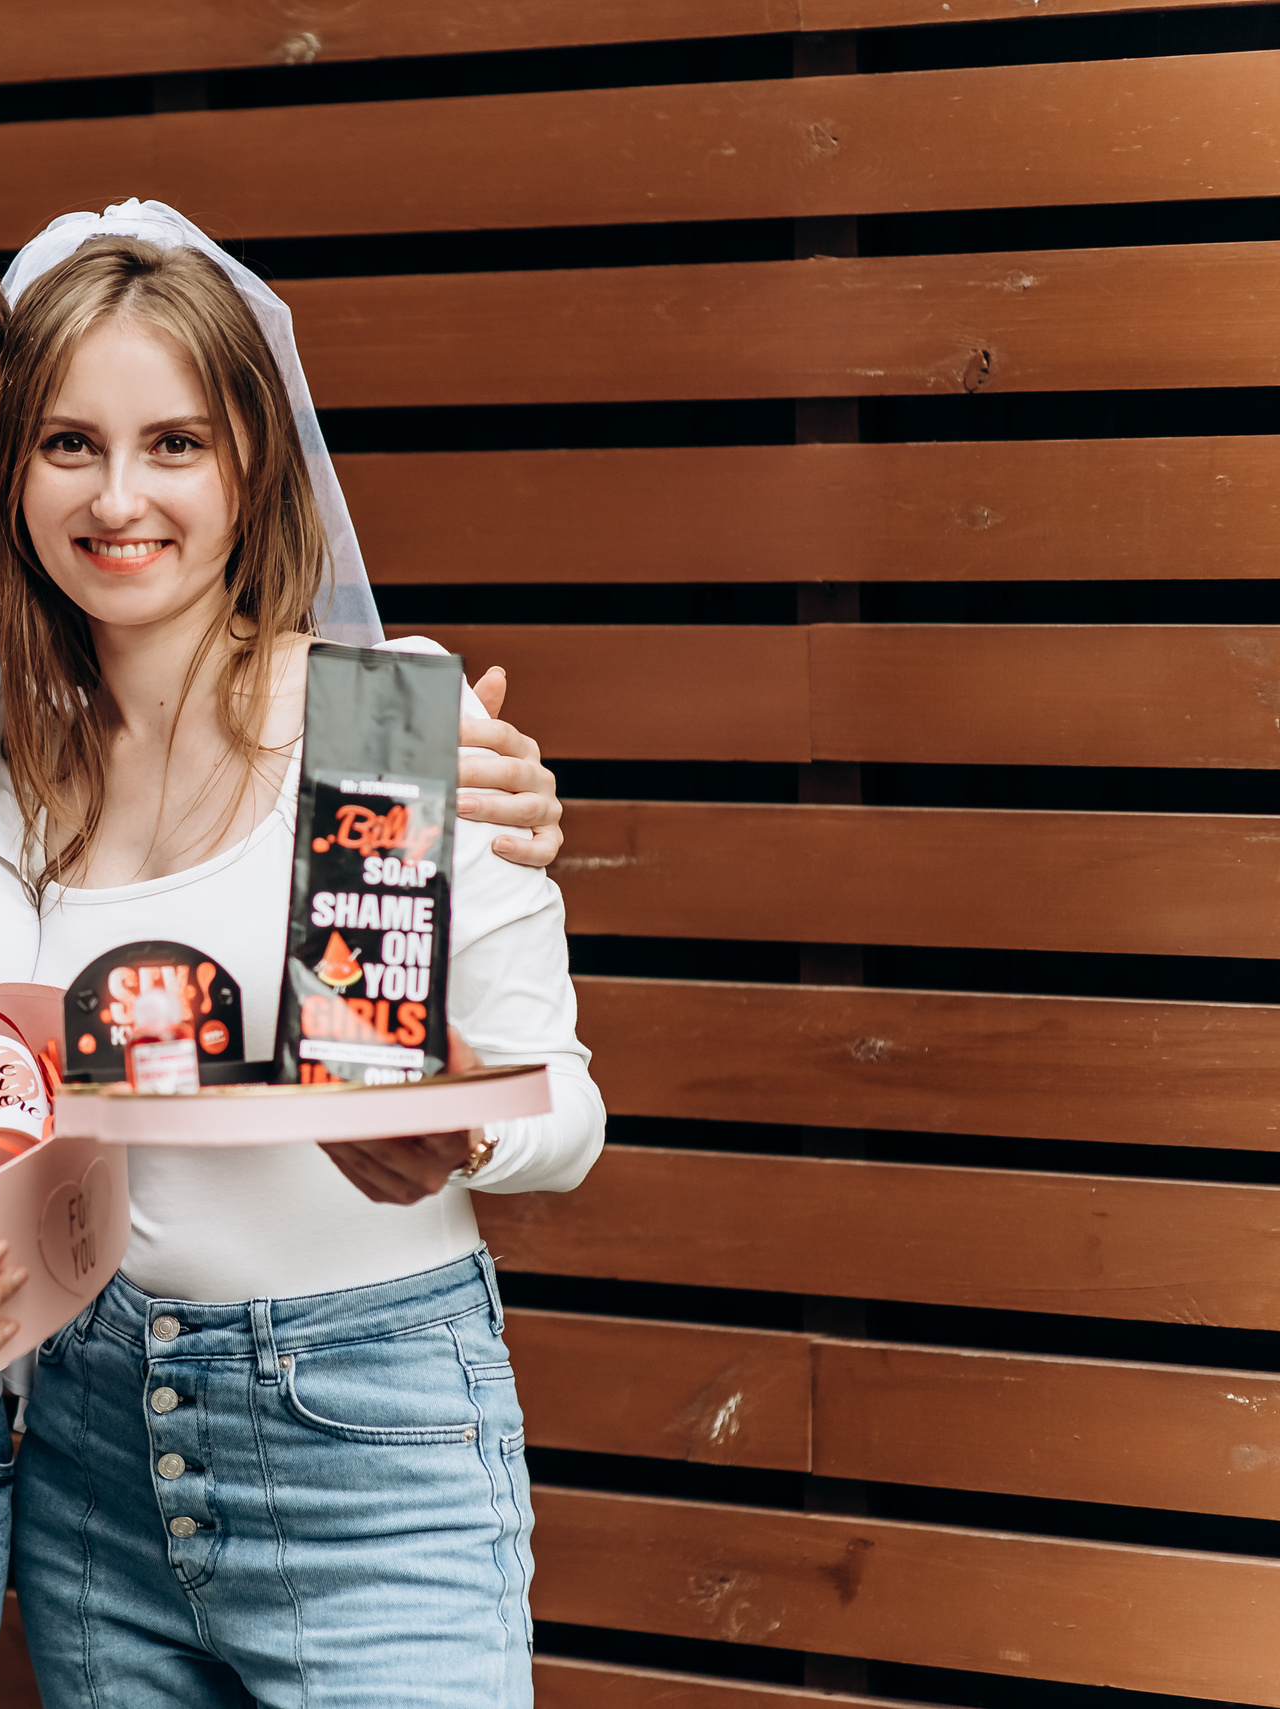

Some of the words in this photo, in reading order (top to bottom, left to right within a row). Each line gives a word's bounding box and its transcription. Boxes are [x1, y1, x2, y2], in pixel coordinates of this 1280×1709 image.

[363, 857, 437, 888] SOAP
[311, 891, 435, 932] SHAME
[382, 931, 433, 967] ON
[363, 962, 431, 1002] YOU
[301, 995, 427, 1046] GIRLS
[72, 1231, 96, 1281] YOU
